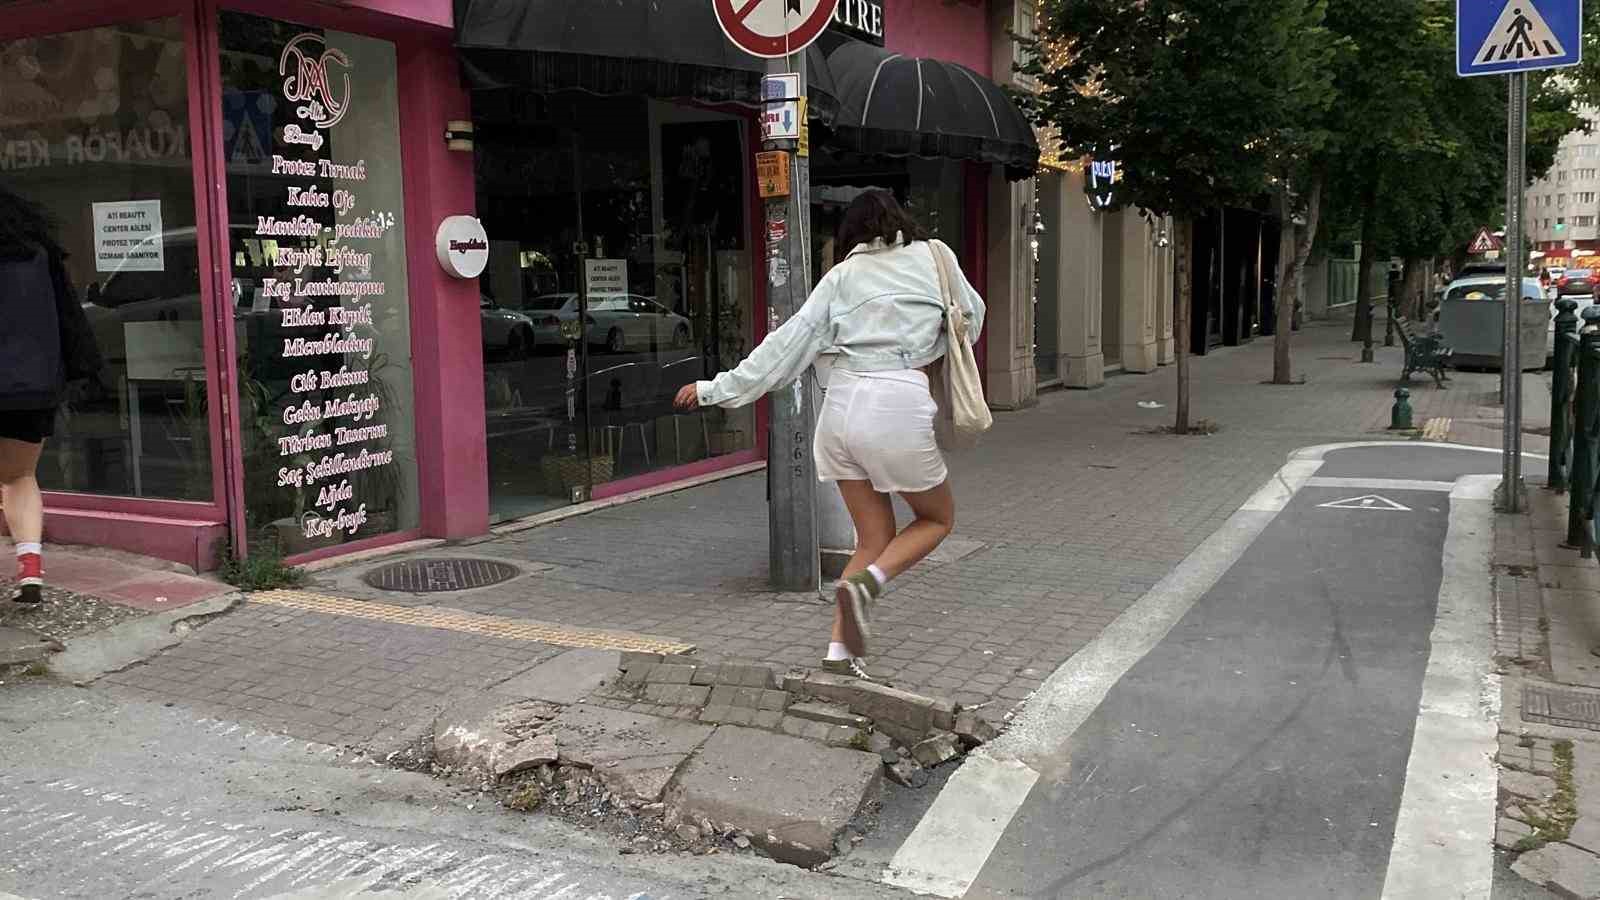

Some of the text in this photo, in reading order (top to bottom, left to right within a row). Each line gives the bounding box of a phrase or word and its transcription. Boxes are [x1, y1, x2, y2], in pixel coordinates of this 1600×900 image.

[835, 0, 883, 37] TRE
[272, 155, 316, 176] Protez
[332, 190, 355, 216] Oje
[256, 215, 321, 236] Manikür
[275, 244, 372, 274] Kirpik Lifting
[262, 278, 385, 303] Kaş Laminasyonu
[282, 332, 373, 360] Microblading
[290, 369, 318, 393] Cilt
[283, 400, 321, 425] Gelin
[278, 429, 332, 456] Türban
[277, 448, 393, 488] Saç Şekillendirme
[315, 479, 353, 512] Ağda
